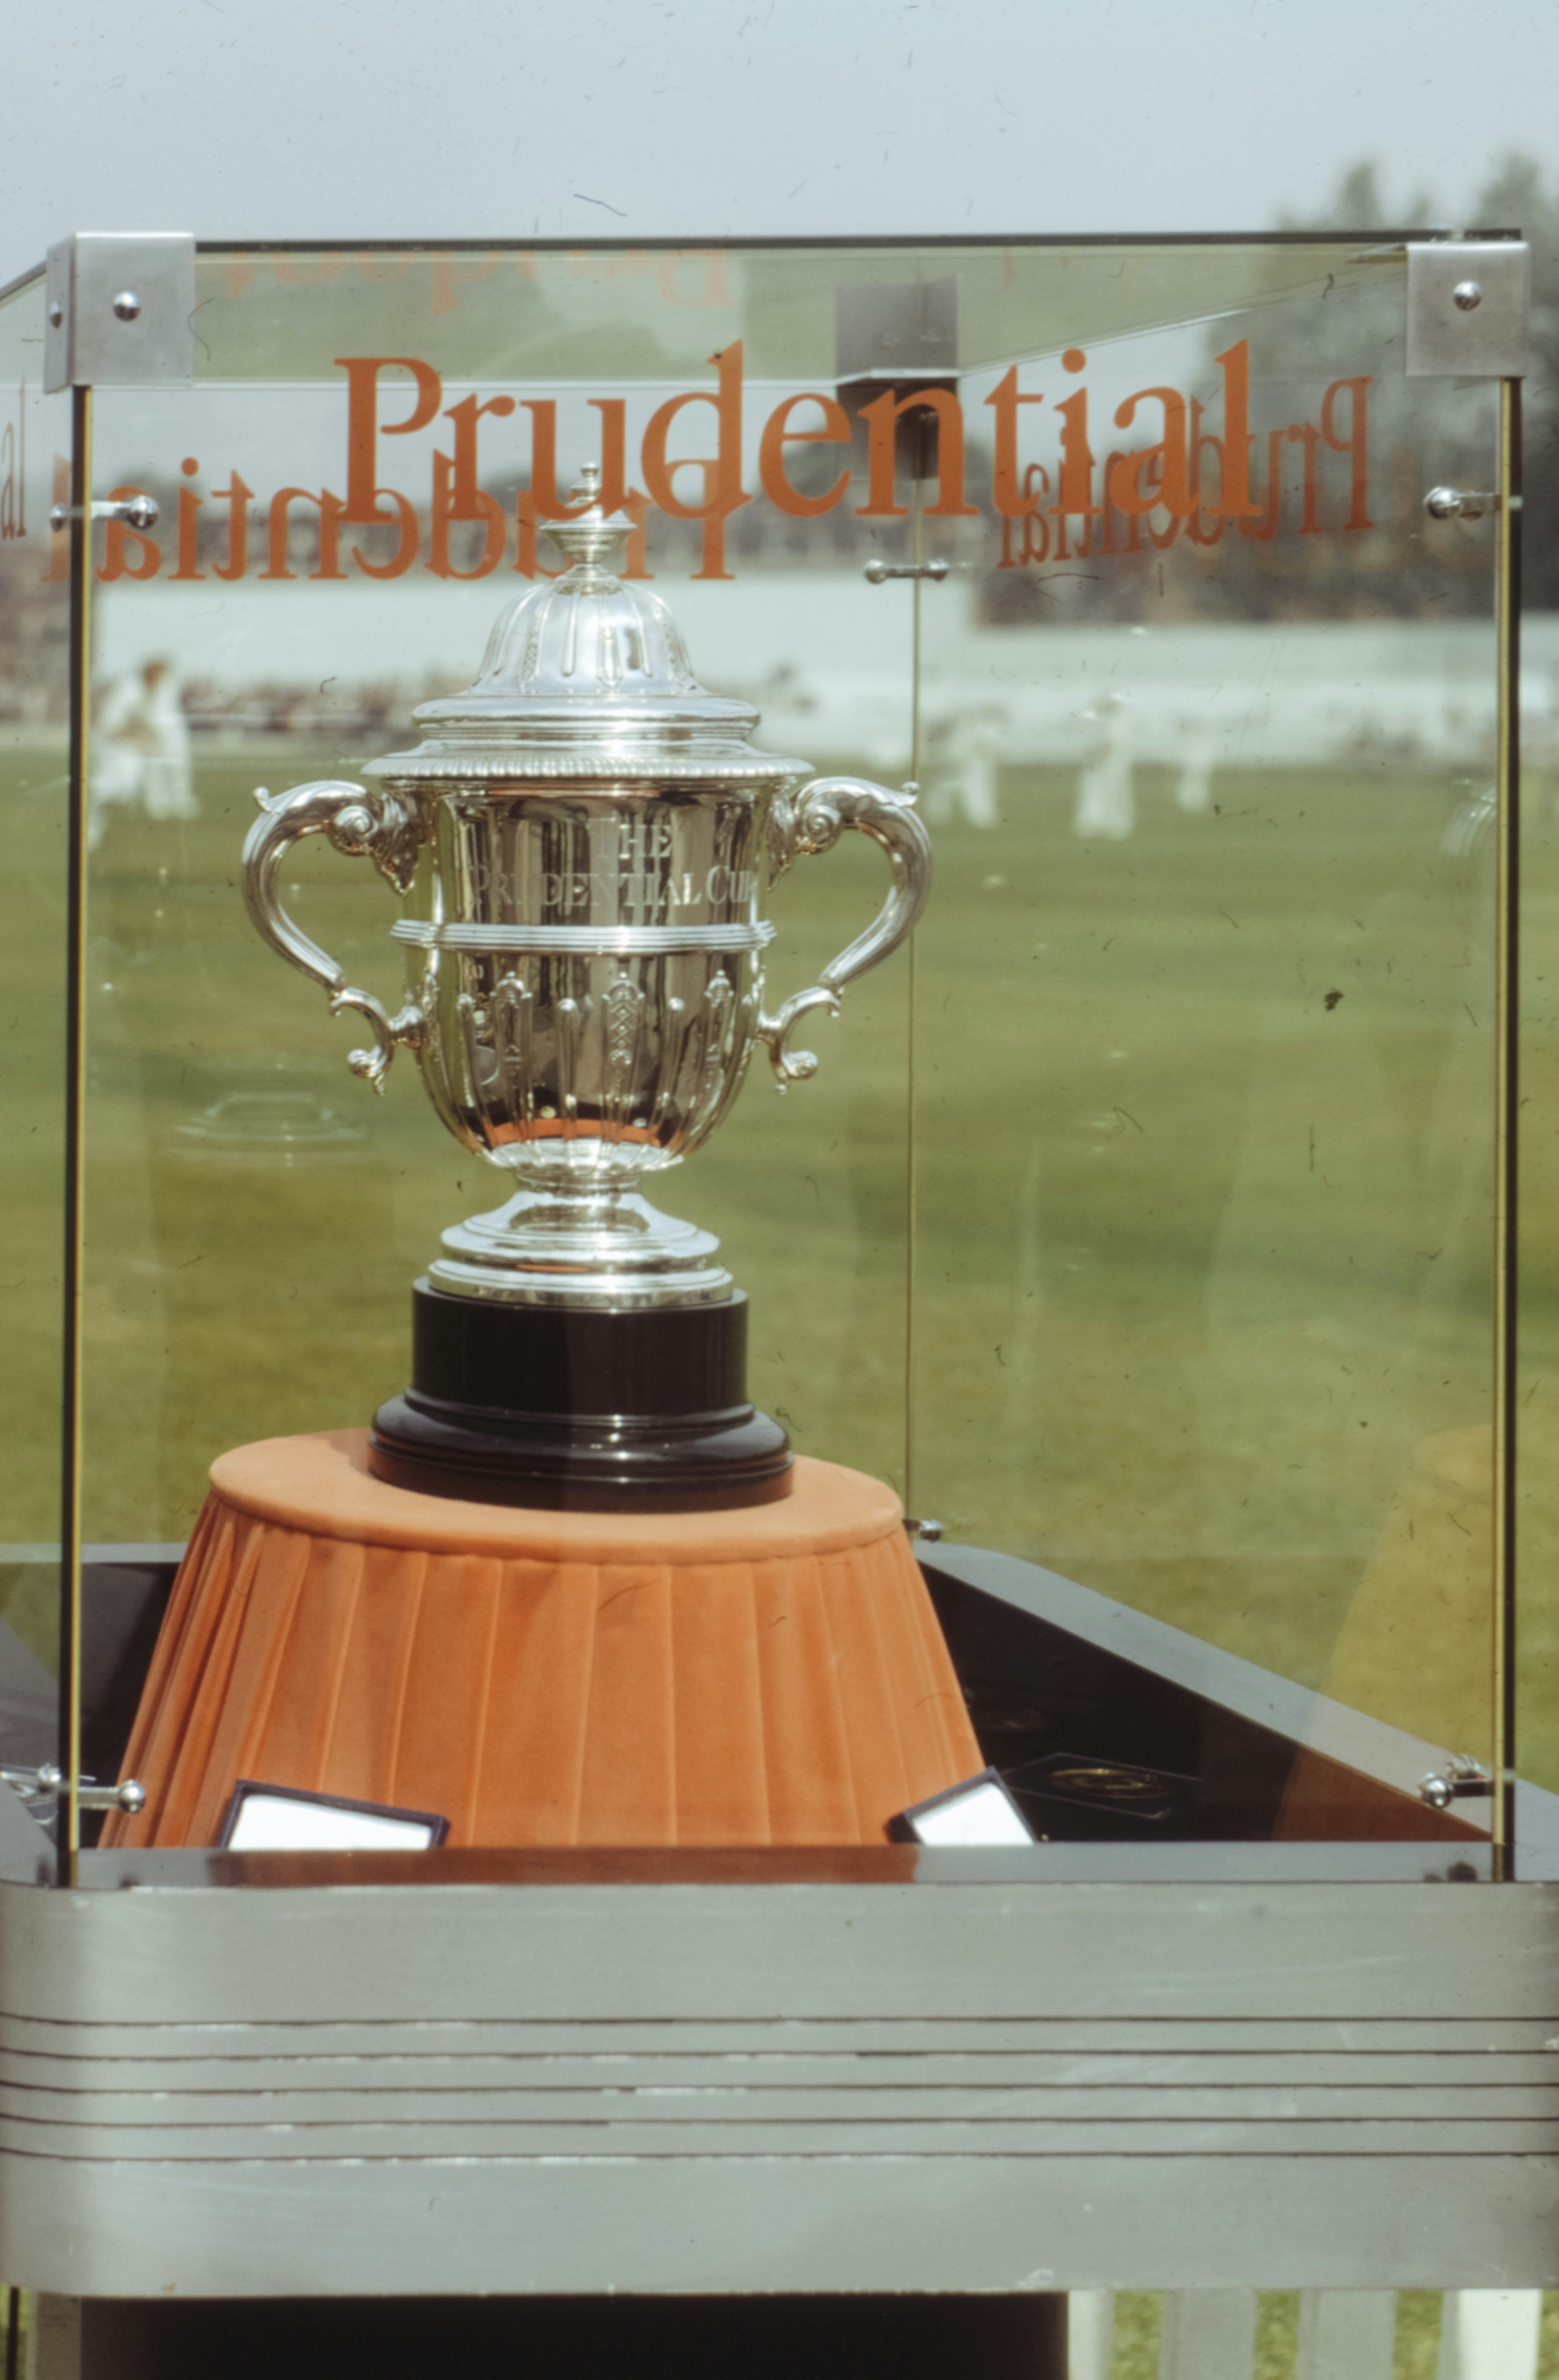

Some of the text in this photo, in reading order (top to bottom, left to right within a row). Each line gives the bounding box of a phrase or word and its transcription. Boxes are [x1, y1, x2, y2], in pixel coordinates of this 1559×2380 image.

[334, 338, 1265, 525] Prudential
[587, 817, 671, 859] THE
[469, 864, 702, 906] PRDENTIAL
